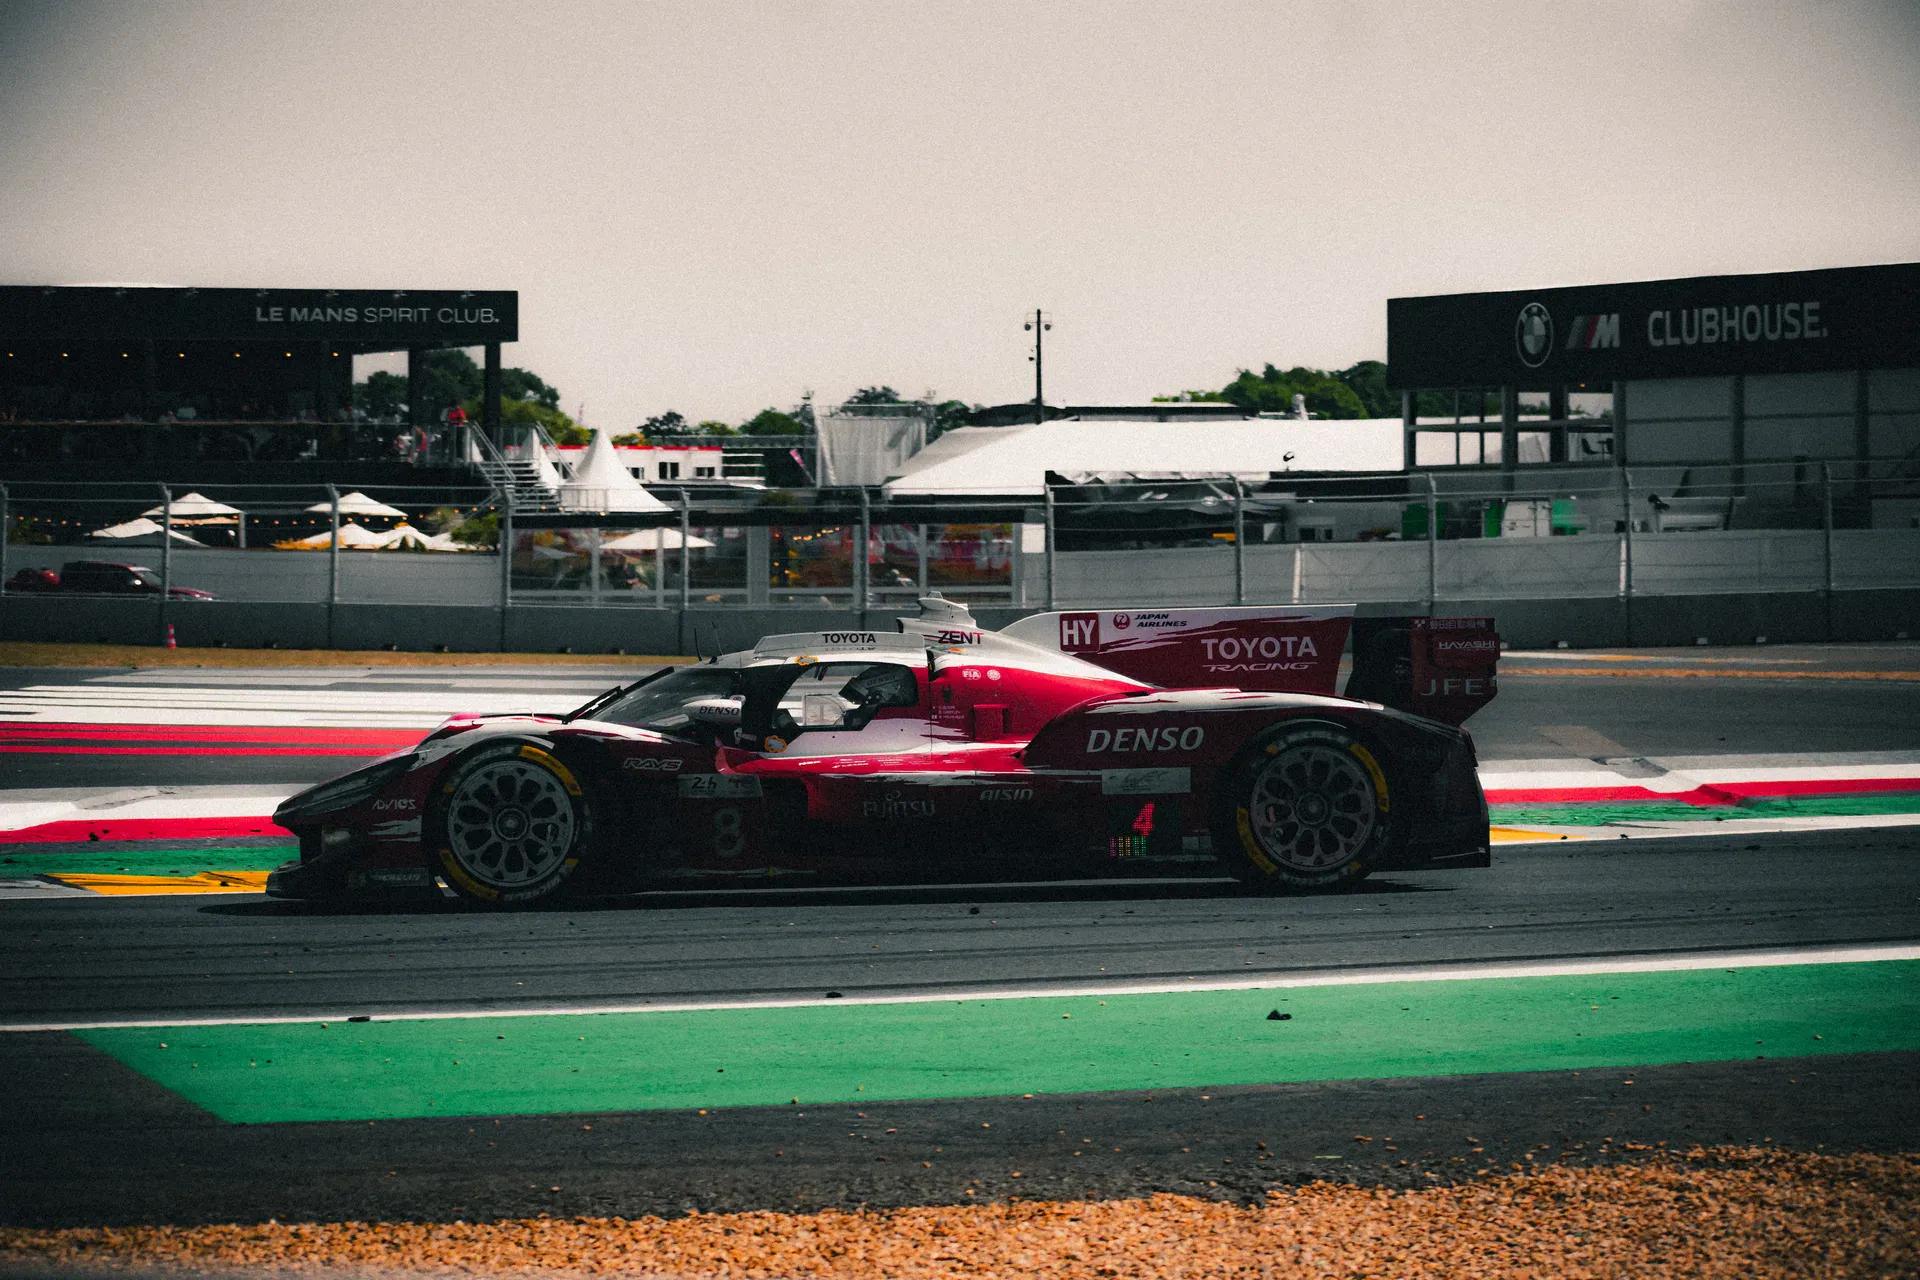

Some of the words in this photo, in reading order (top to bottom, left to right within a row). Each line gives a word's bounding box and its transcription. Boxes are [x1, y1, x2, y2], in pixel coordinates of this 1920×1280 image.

[255, 307, 284, 322] LE
[290, 307, 359, 323] MANS
[364, 307, 431, 323] SPIRIT
[437, 307, 500, 323] CLUB.
[1647, 301, 1828, 347] CLUBHOUSE.
[1133, 613, 1169, 621] JAPAN
[1136, 620, 1187, 628] AIRLINES
[822, 633, 876, 644] TOYOTA
[938, 630, 984, 645] ZENT
[1062, 619, 1097, 646] HY
[1200, 635, 1318, 660] TOYOTA
[1438, 640, 1496, 650] HAYASHI
[963, 670, 981, 679] FIA
[1202, 661, 1318, 673] RACING
[1420, 678, 1484, 696] JFE
[698, 706, 740, 717] DENSO
[1086, 726, 1205, 753] DENSO
[623, 757, 683, 772] RAYS
[862, 791, 936, 818] FUJITSU
[1132, 802, 1155, 837] 4
[714, 807, 746, 858] 8
